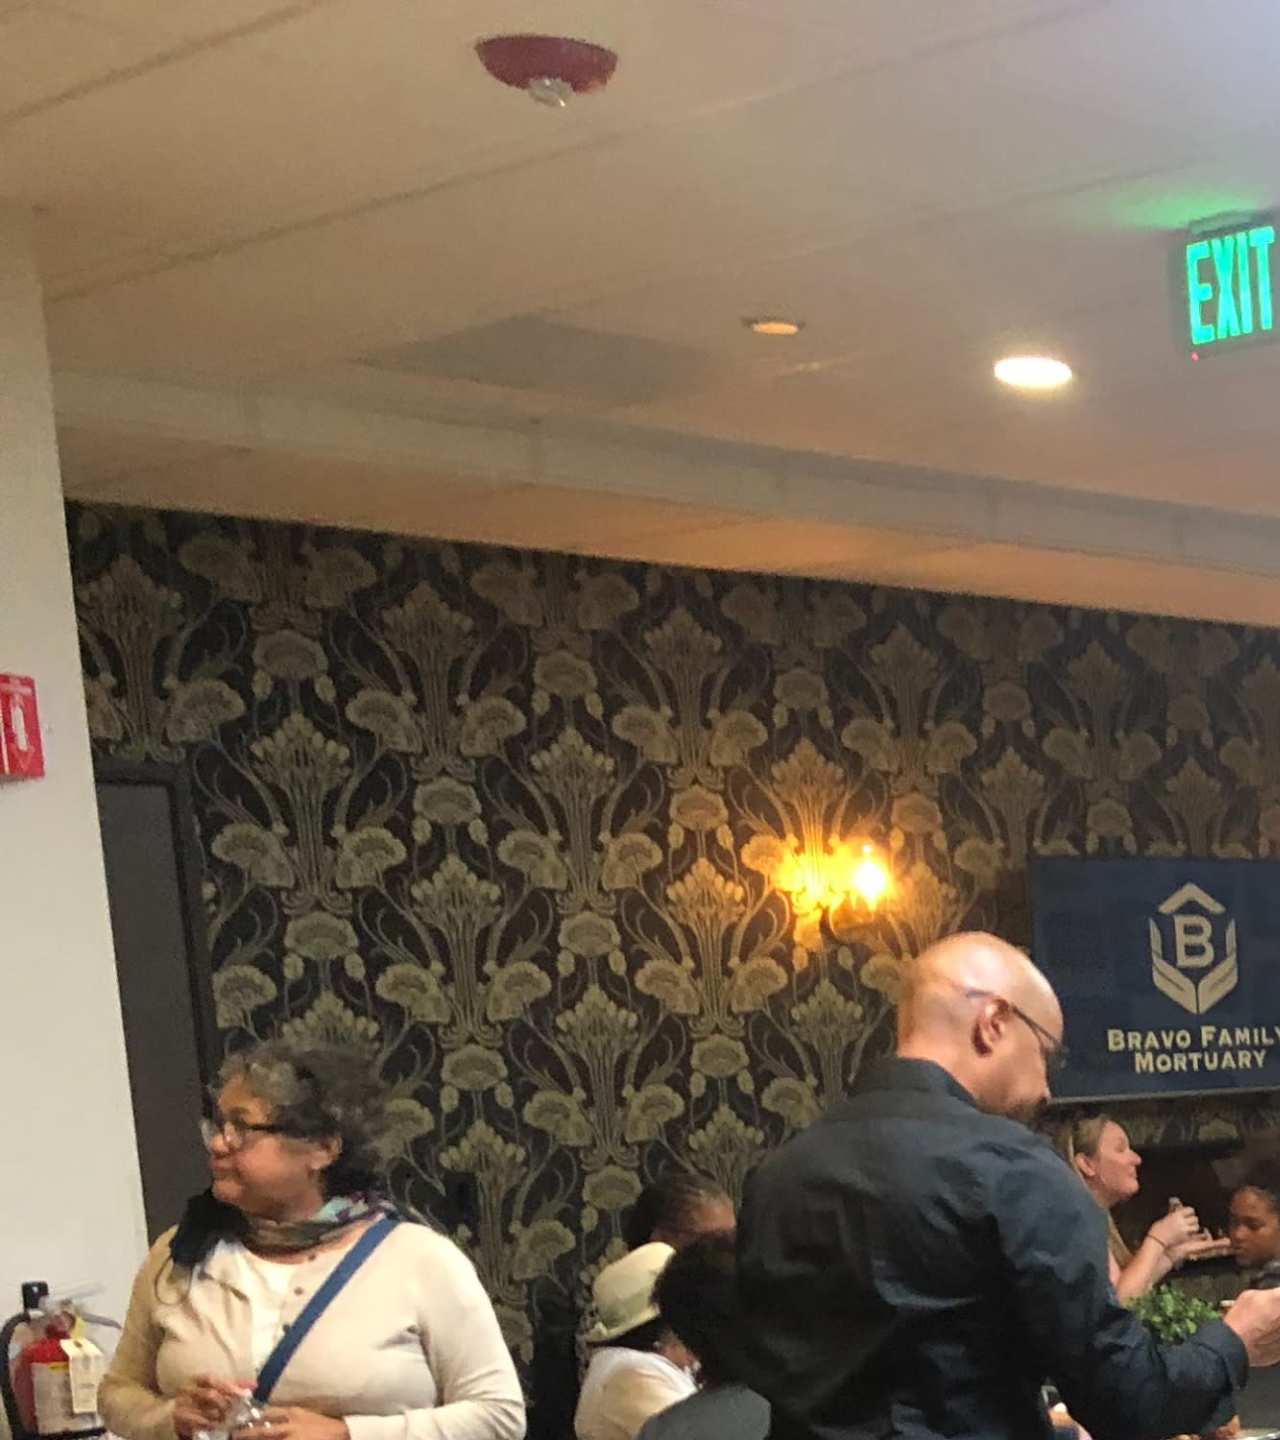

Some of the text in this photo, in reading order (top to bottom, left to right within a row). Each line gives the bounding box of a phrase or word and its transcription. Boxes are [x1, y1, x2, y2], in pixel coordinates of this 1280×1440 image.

[1187, 226, 1275, 344] EXIT
[1173, 914, 1214, 969] B
[1107, 1028, 1191, 1051] BRAVO
[1135, 1051, 1267, 1073] MORTUARY
